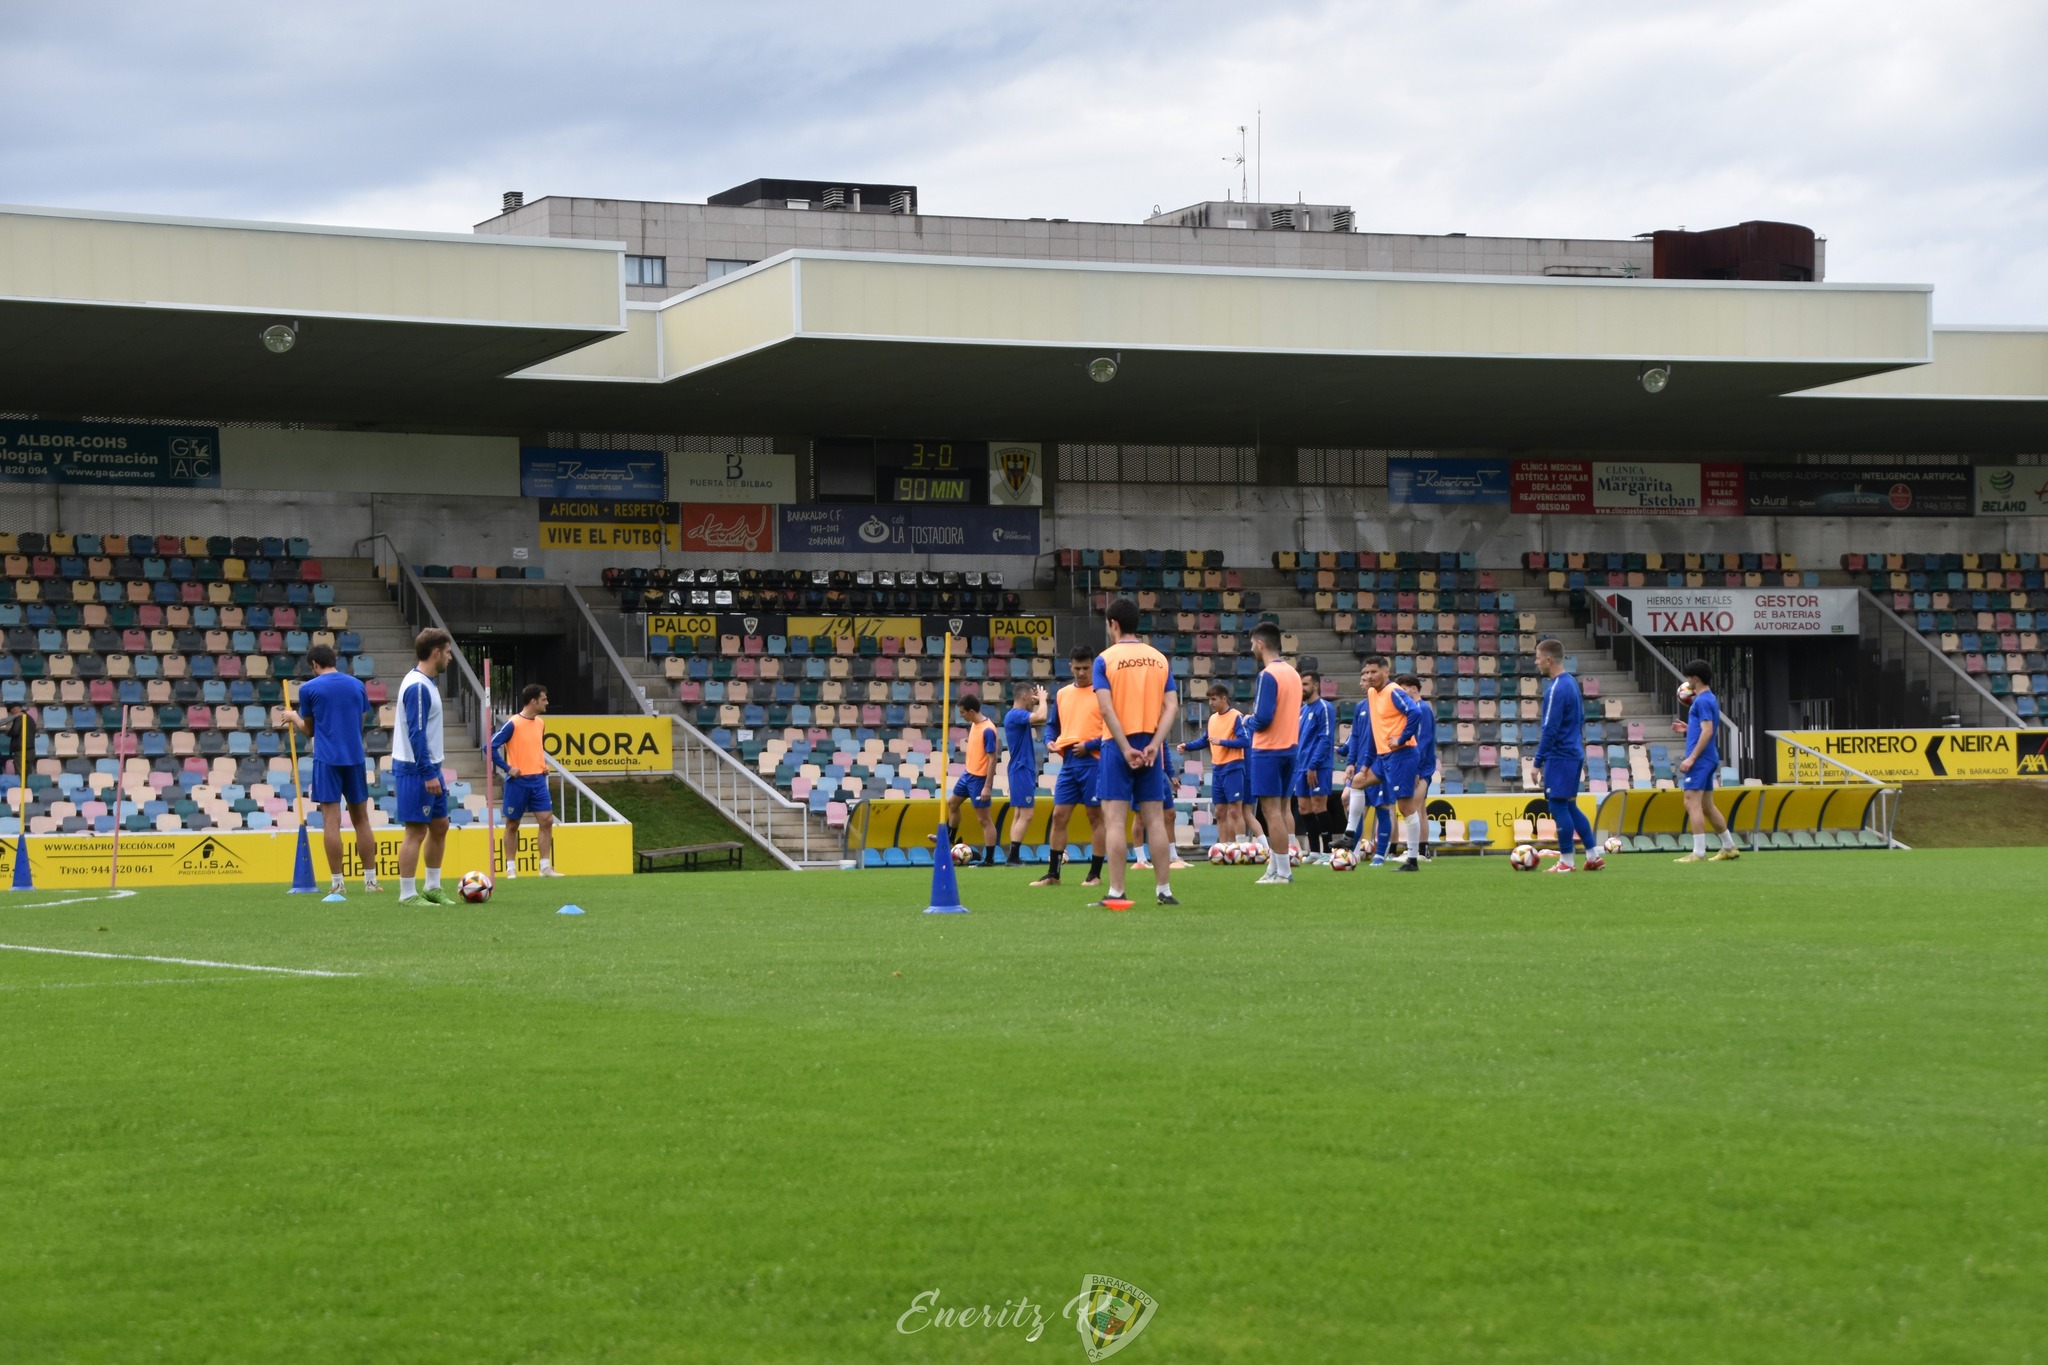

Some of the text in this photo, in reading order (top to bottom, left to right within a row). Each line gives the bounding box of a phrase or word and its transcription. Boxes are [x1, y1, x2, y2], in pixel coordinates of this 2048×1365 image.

[17, 433, 128, 449] ALBOR-COHS
[0, 448, 159, 465] logía y Formación
[5, 465, 48, 475] 820 094
[1521, 461, 1583, 472] CLÍNICA MEDICINA
[1605, 465, 1645, 475] CLINICA
[65, 469, 156, 479] www.gac.com.es
[1515, 471, 1589, 482] ESTÉTICA Y CAPILAR
[1749, 472, 1759, 480] EL
[1761, 472, 1793, 480] PRIMER
[1841, 472, 1860, 480] CON
[1861, 472, 1921, 481] INTELIGENCIA
[689, 479, 773, 488] PUERTA DE BILBAO
[900, 477, 964, 501] 90 MIN
[1531, 482, 1573, 491] DEPILACIÓN
[1597, 477, 1673, 496] Margarita
[1519, 493, 1586, 501] REJUVENECIMIENTO
[1639, 493, 1696, 507] Esteban
[1762, 495, 1788, 506] Aural
[550, 502, 599, 517] AFICION
[614, 503, 670, 517] RESPETO:
[1536, 503, 1570, 511] OBESIDAD
[787, 510, 828, 522] BARAKALDO
[810, 524, 840, 534] 1917-2017
[547, 527, 582, 544] VIVE
[589, 528, 607, 544] EL
[892, 526, 965, 545] LA TOSTADORA
[1646, 595, 1733, 605] HIERROS Y METALES
[1755, 595, 1819, 608] GESTOR
[1754, 611, 1821, 619] DE BATERIAS
[654, 618, 711, 634] PALCO
[1647, 610, 1734, 632] TXAKO
[1754, 622, 1821, 631] AUTORIZADO
[994, 620, 1048, 635] PALCO
[1826, 736, 1918, 754] HERRERO
[1950, 734, 2010, 752] NEIRA
[574, 758, 593, 767] que
[596, 756, 641, 765] escucha.
[2017, 754, 2048, 772] AXA
[91, 865, 111, 874] 944
[135, 864, 154, 873] 061
[183, 860, 240, 869] C.I.S.A.
